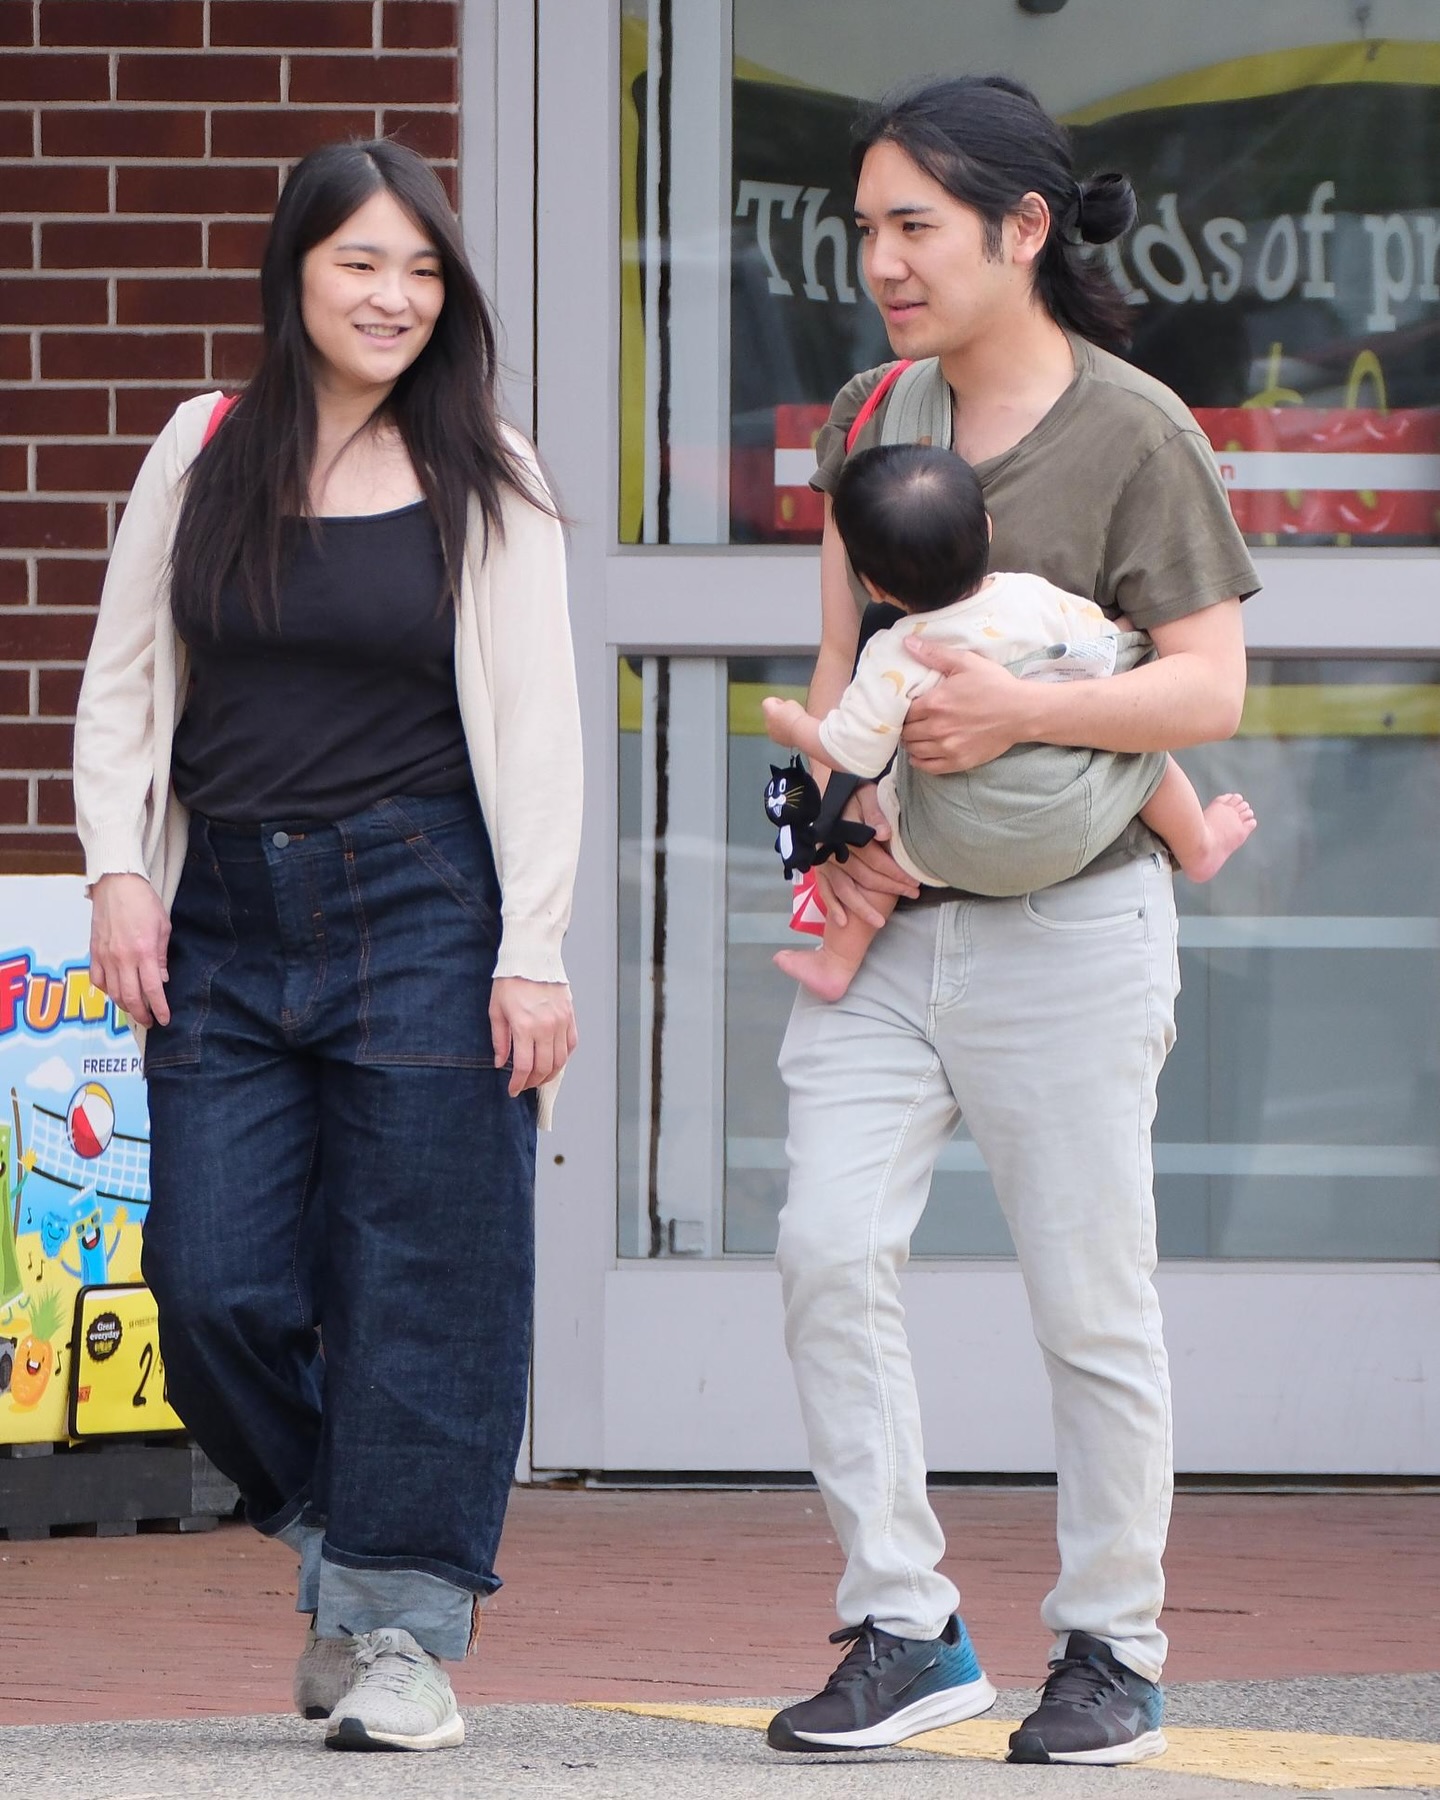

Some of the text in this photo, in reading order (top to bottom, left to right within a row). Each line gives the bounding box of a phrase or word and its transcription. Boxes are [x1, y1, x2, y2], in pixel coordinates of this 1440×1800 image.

[1257, 181, 1335, 301] of
[0, 954, 129, 1035] FUN
[83, 1058, 127, 1073] FREEZE
[97, 1320, 115, 1331] Great
[89, 1329, 120, 1341] everyday
